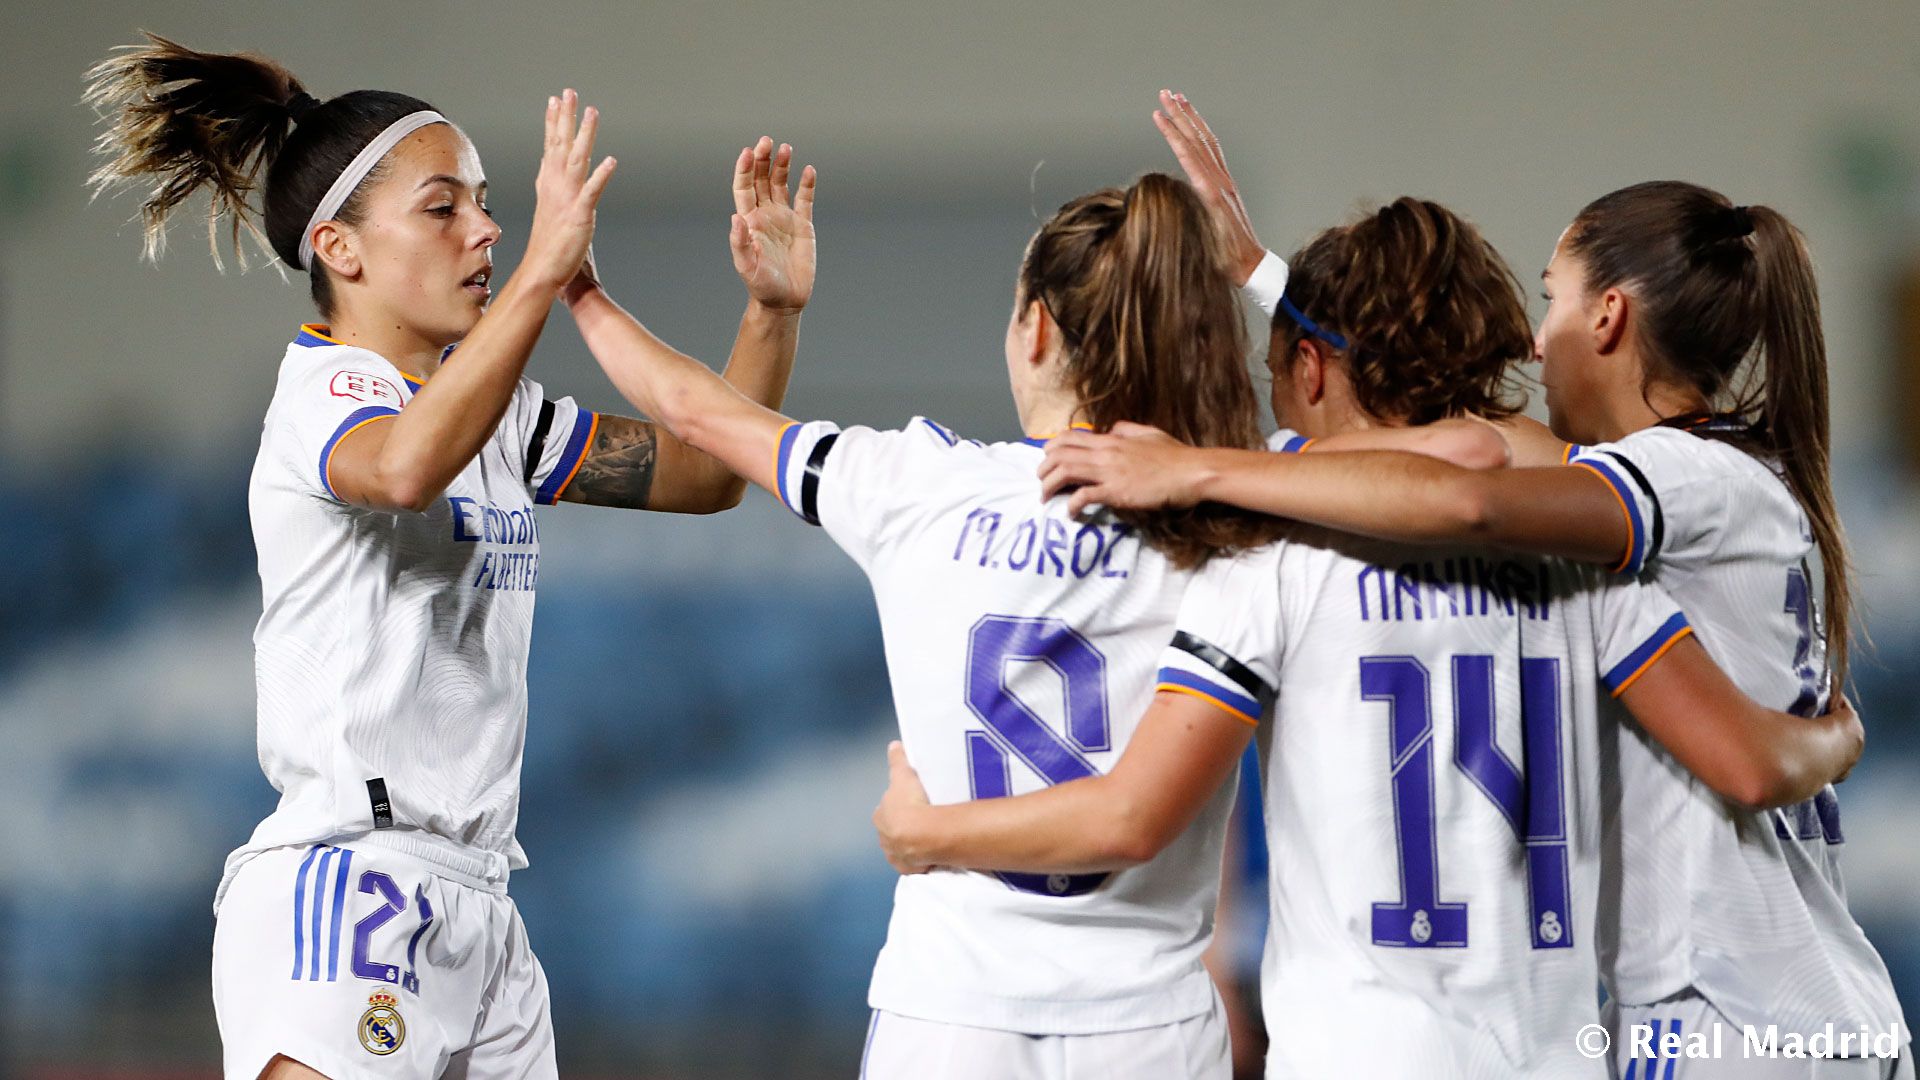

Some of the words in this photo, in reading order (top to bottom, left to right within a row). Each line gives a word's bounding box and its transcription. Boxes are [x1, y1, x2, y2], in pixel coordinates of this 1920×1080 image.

[448, 497, 540, 545] Emirat
[1359, 654, 1575, 950] 14
[350, 869, 434, 998] 21
